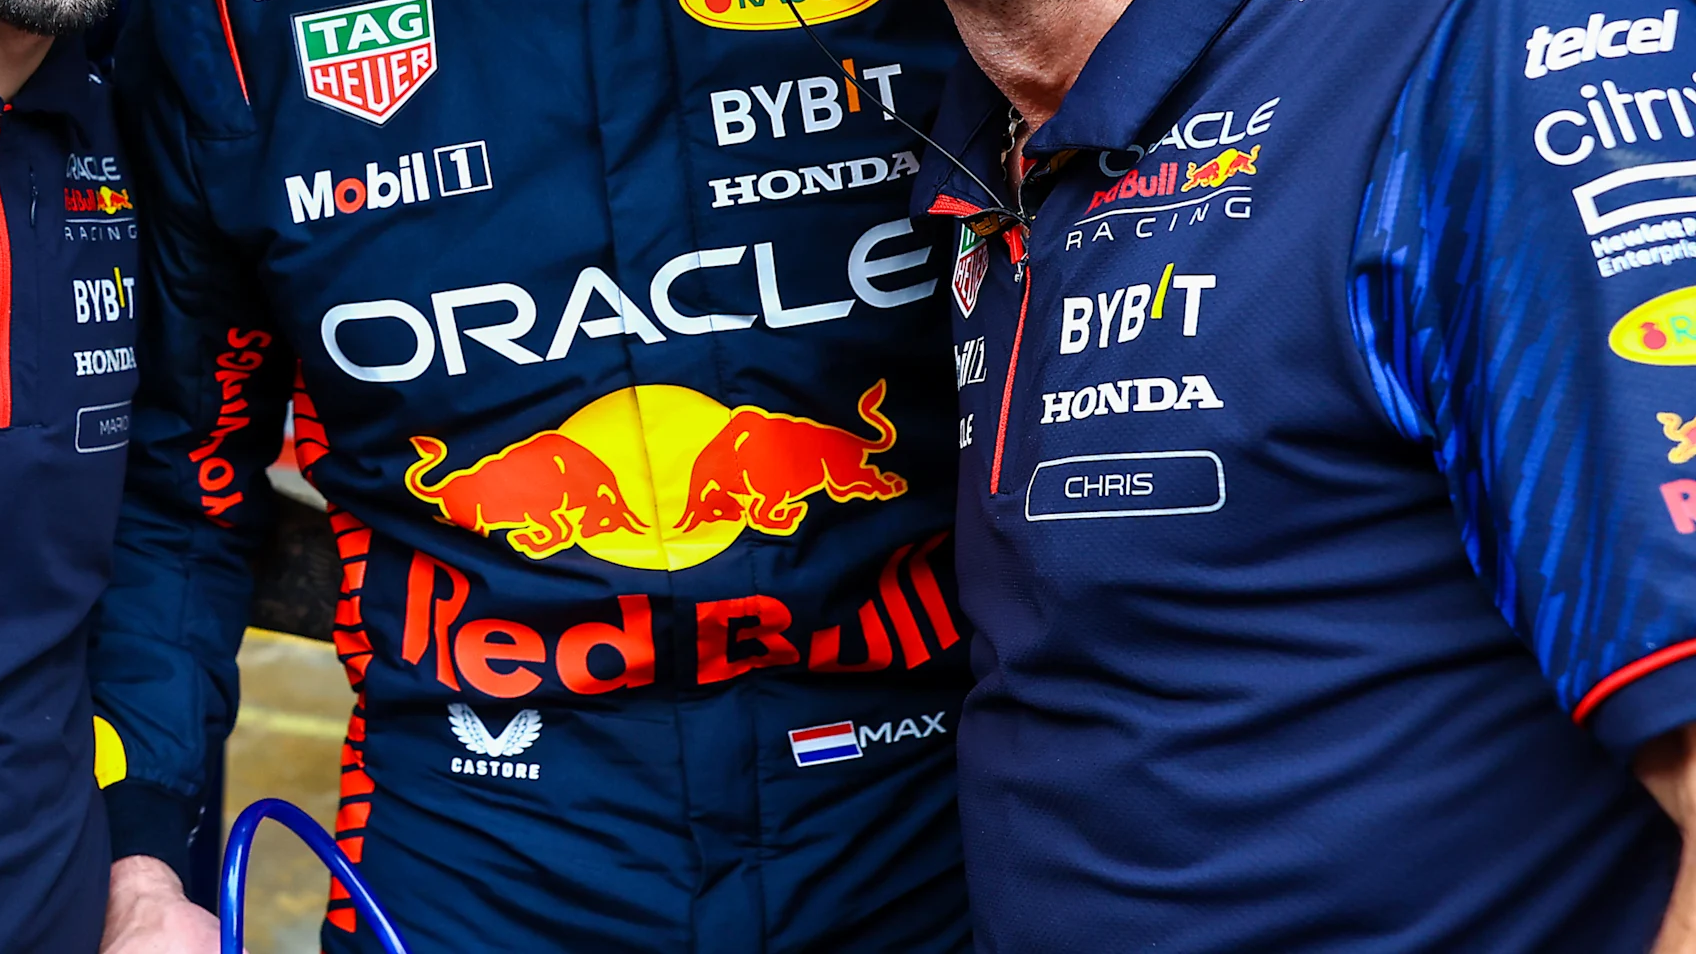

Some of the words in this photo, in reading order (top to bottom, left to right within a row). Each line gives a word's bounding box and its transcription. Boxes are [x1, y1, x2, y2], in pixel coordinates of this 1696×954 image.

[309, 4, 423, 55] TAG
[1524, 9, 1679, 80] telcel
[312, 46, 430, 113] HEUER
[710, 58, 902, 147] BYBIT
[1099, 97, 1281, 178] OACLE
[1534, 79, 1696, 165] citri
[285, 152, 431, 224] Mobil
[709, 151, 921, 208] HONDA
[1118, 161, 1179, 199] Bull
[1065, 197, 1252, 251] RACING
[1597, 238, 1696, 278] Enterpris
[73, 267, 135, 323] BYBIT
[320, 218, 939, 383] ORACLE
[1060, 262, 1217, 355] BYBIT
[73, 346, 137, 376] HONDA
[1040, 374, 1224, 425] HONDA
[1064, 472, 1155, 499] CHRIS
[402, 549, 656, 698] Red
[695, 529, 961, 685] Bull
[860, 710, 947, 749] MAX
[450, 757, 542, 781] CASTORE
